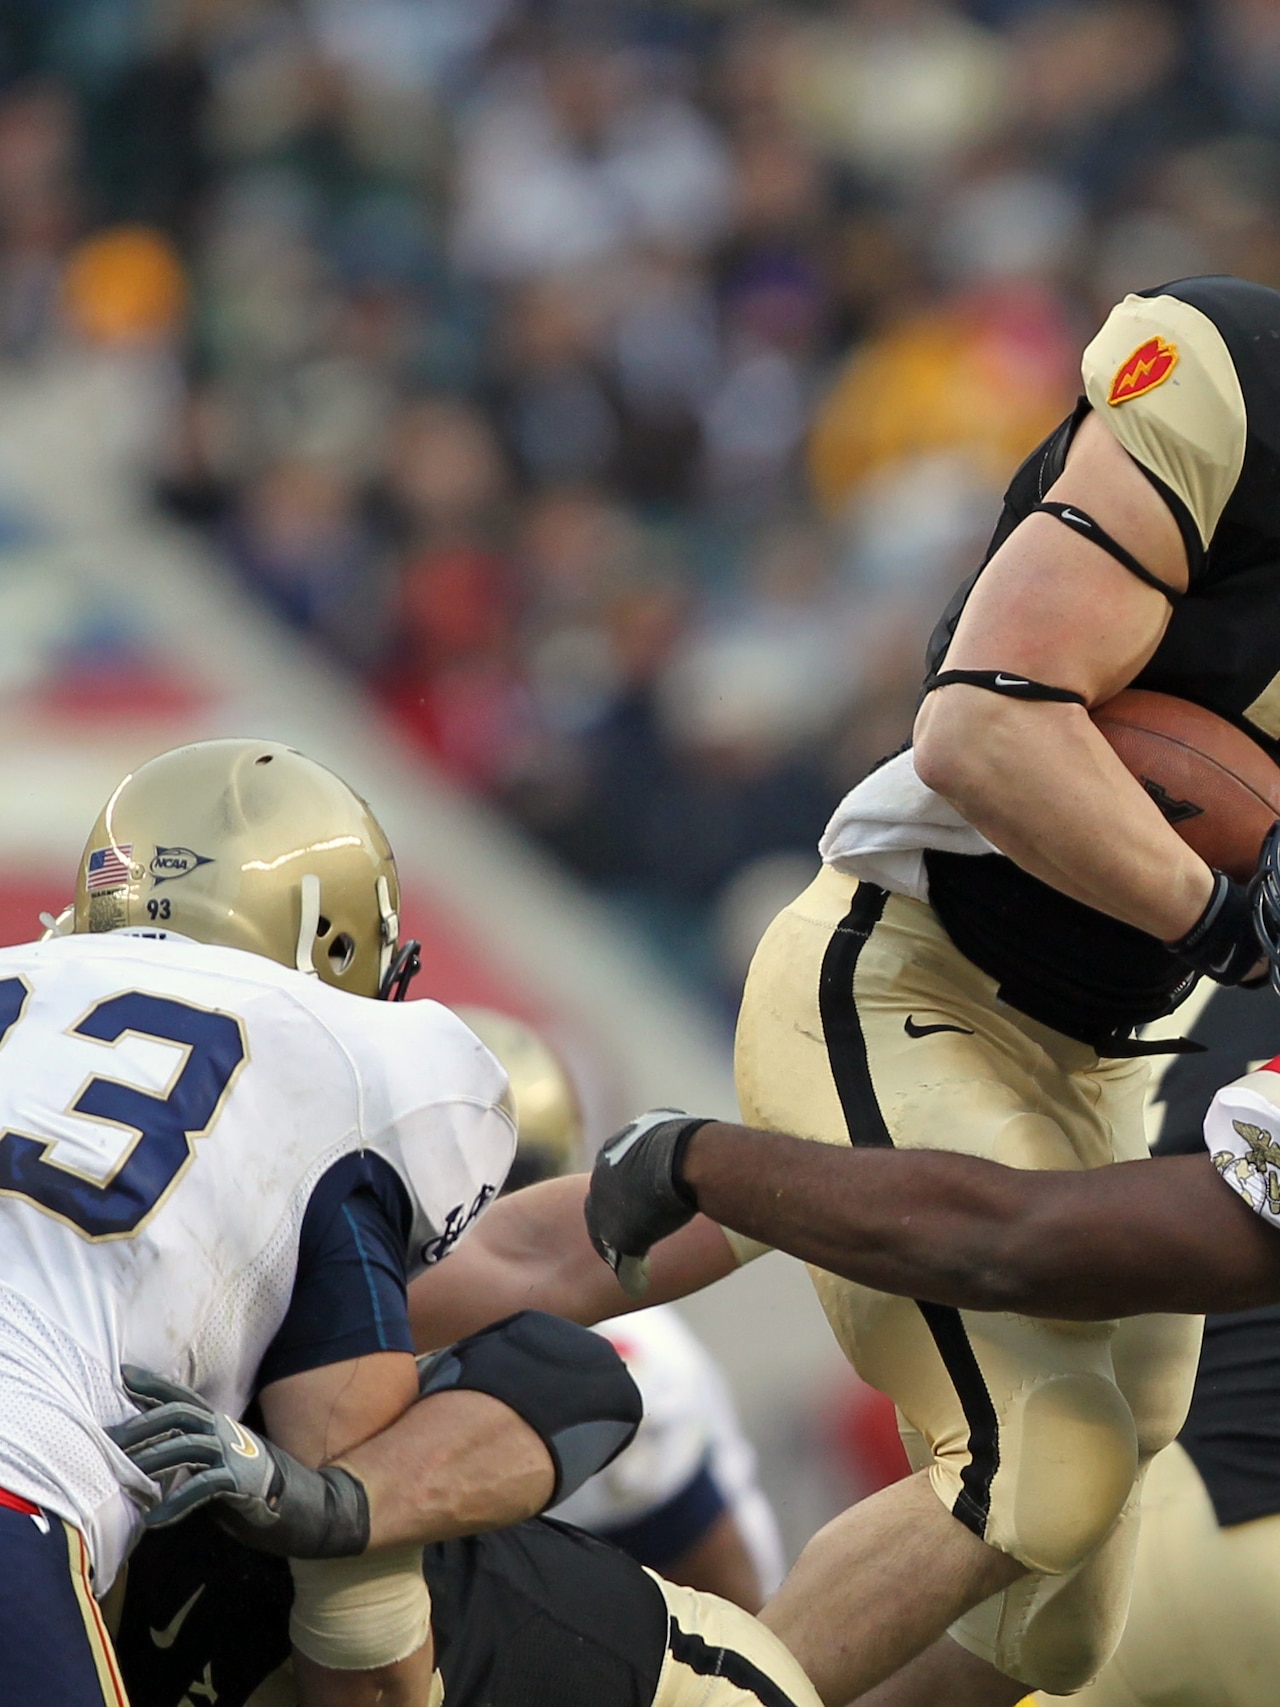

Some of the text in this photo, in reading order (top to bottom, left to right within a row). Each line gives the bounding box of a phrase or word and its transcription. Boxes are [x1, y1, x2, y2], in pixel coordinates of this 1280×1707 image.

[154, 858, 187, 870] NCAA
[147, 898, 171, 920] 93
[0, 973, 251, 1244] 3
